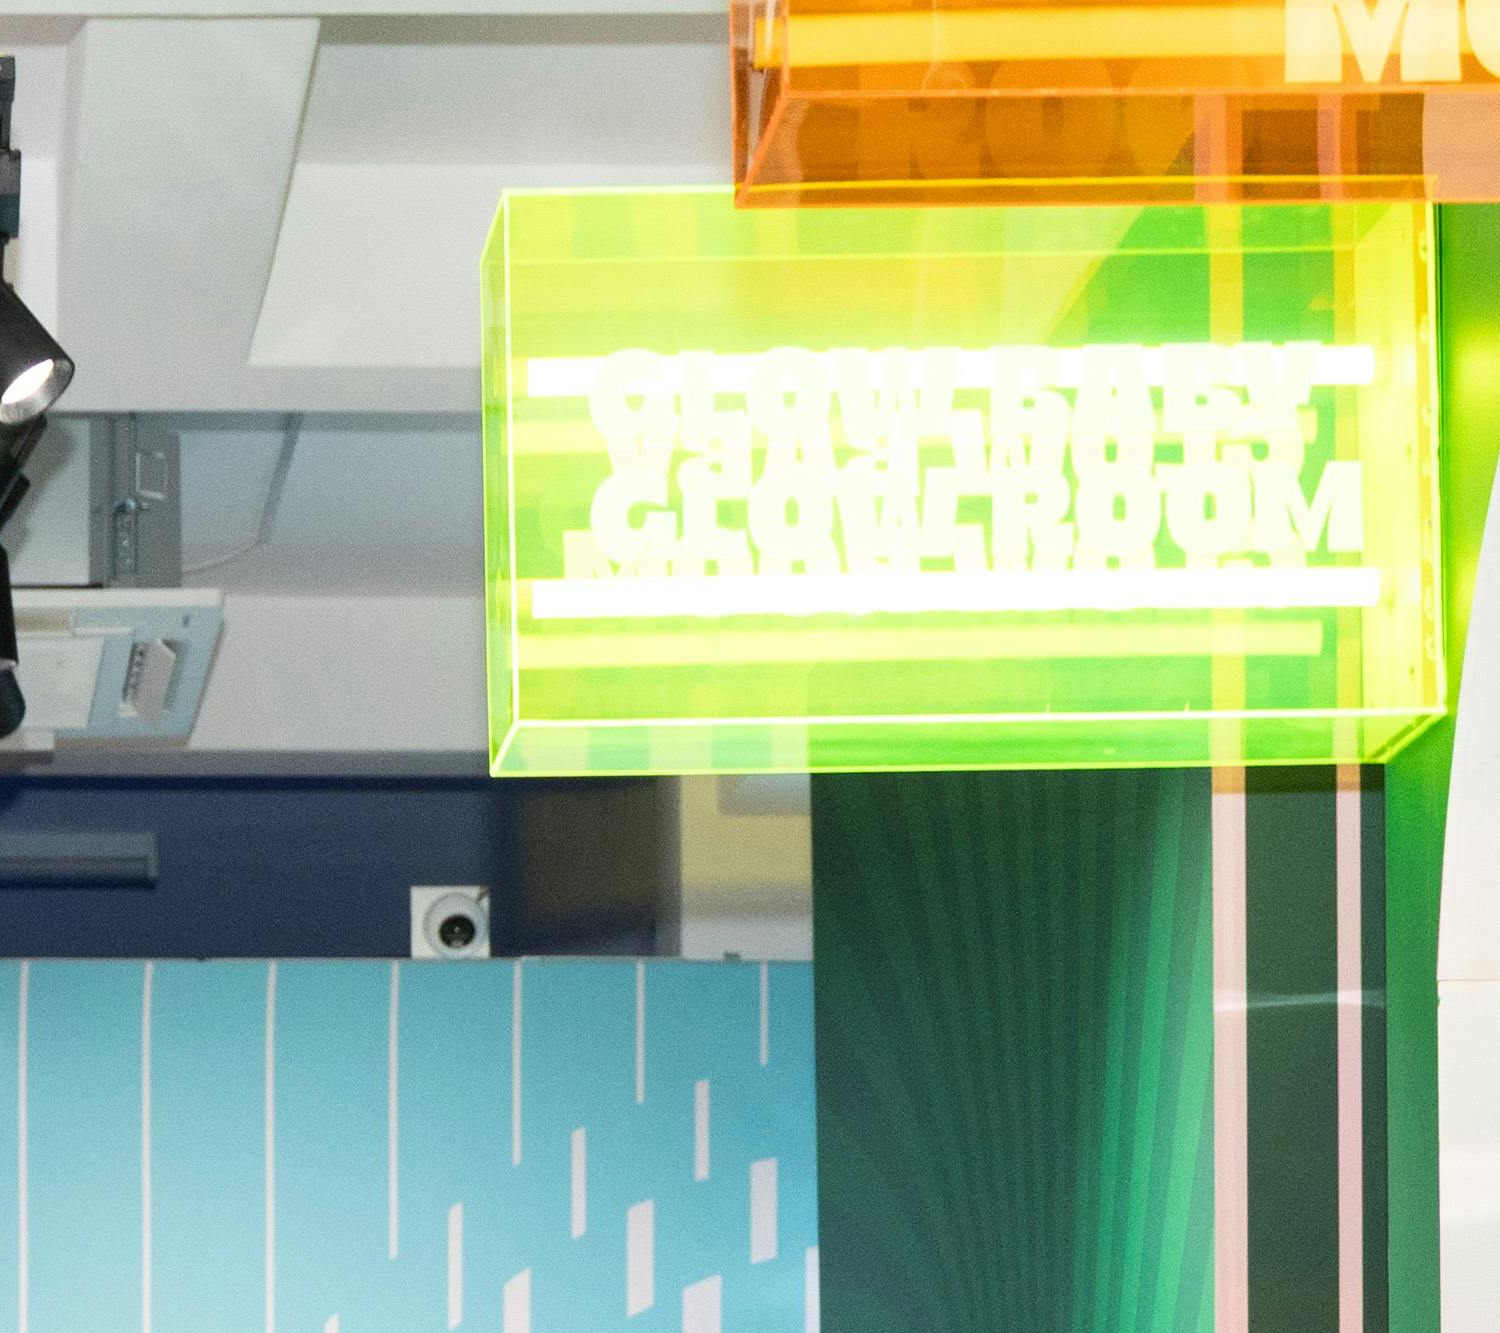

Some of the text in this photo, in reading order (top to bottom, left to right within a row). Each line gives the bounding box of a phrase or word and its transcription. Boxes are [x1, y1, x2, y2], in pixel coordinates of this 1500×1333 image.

[588, 346, 962, 438] GLOW
[590, 463, 965, 561] GLOW
[991, 460, 1364, 556] ROOM
